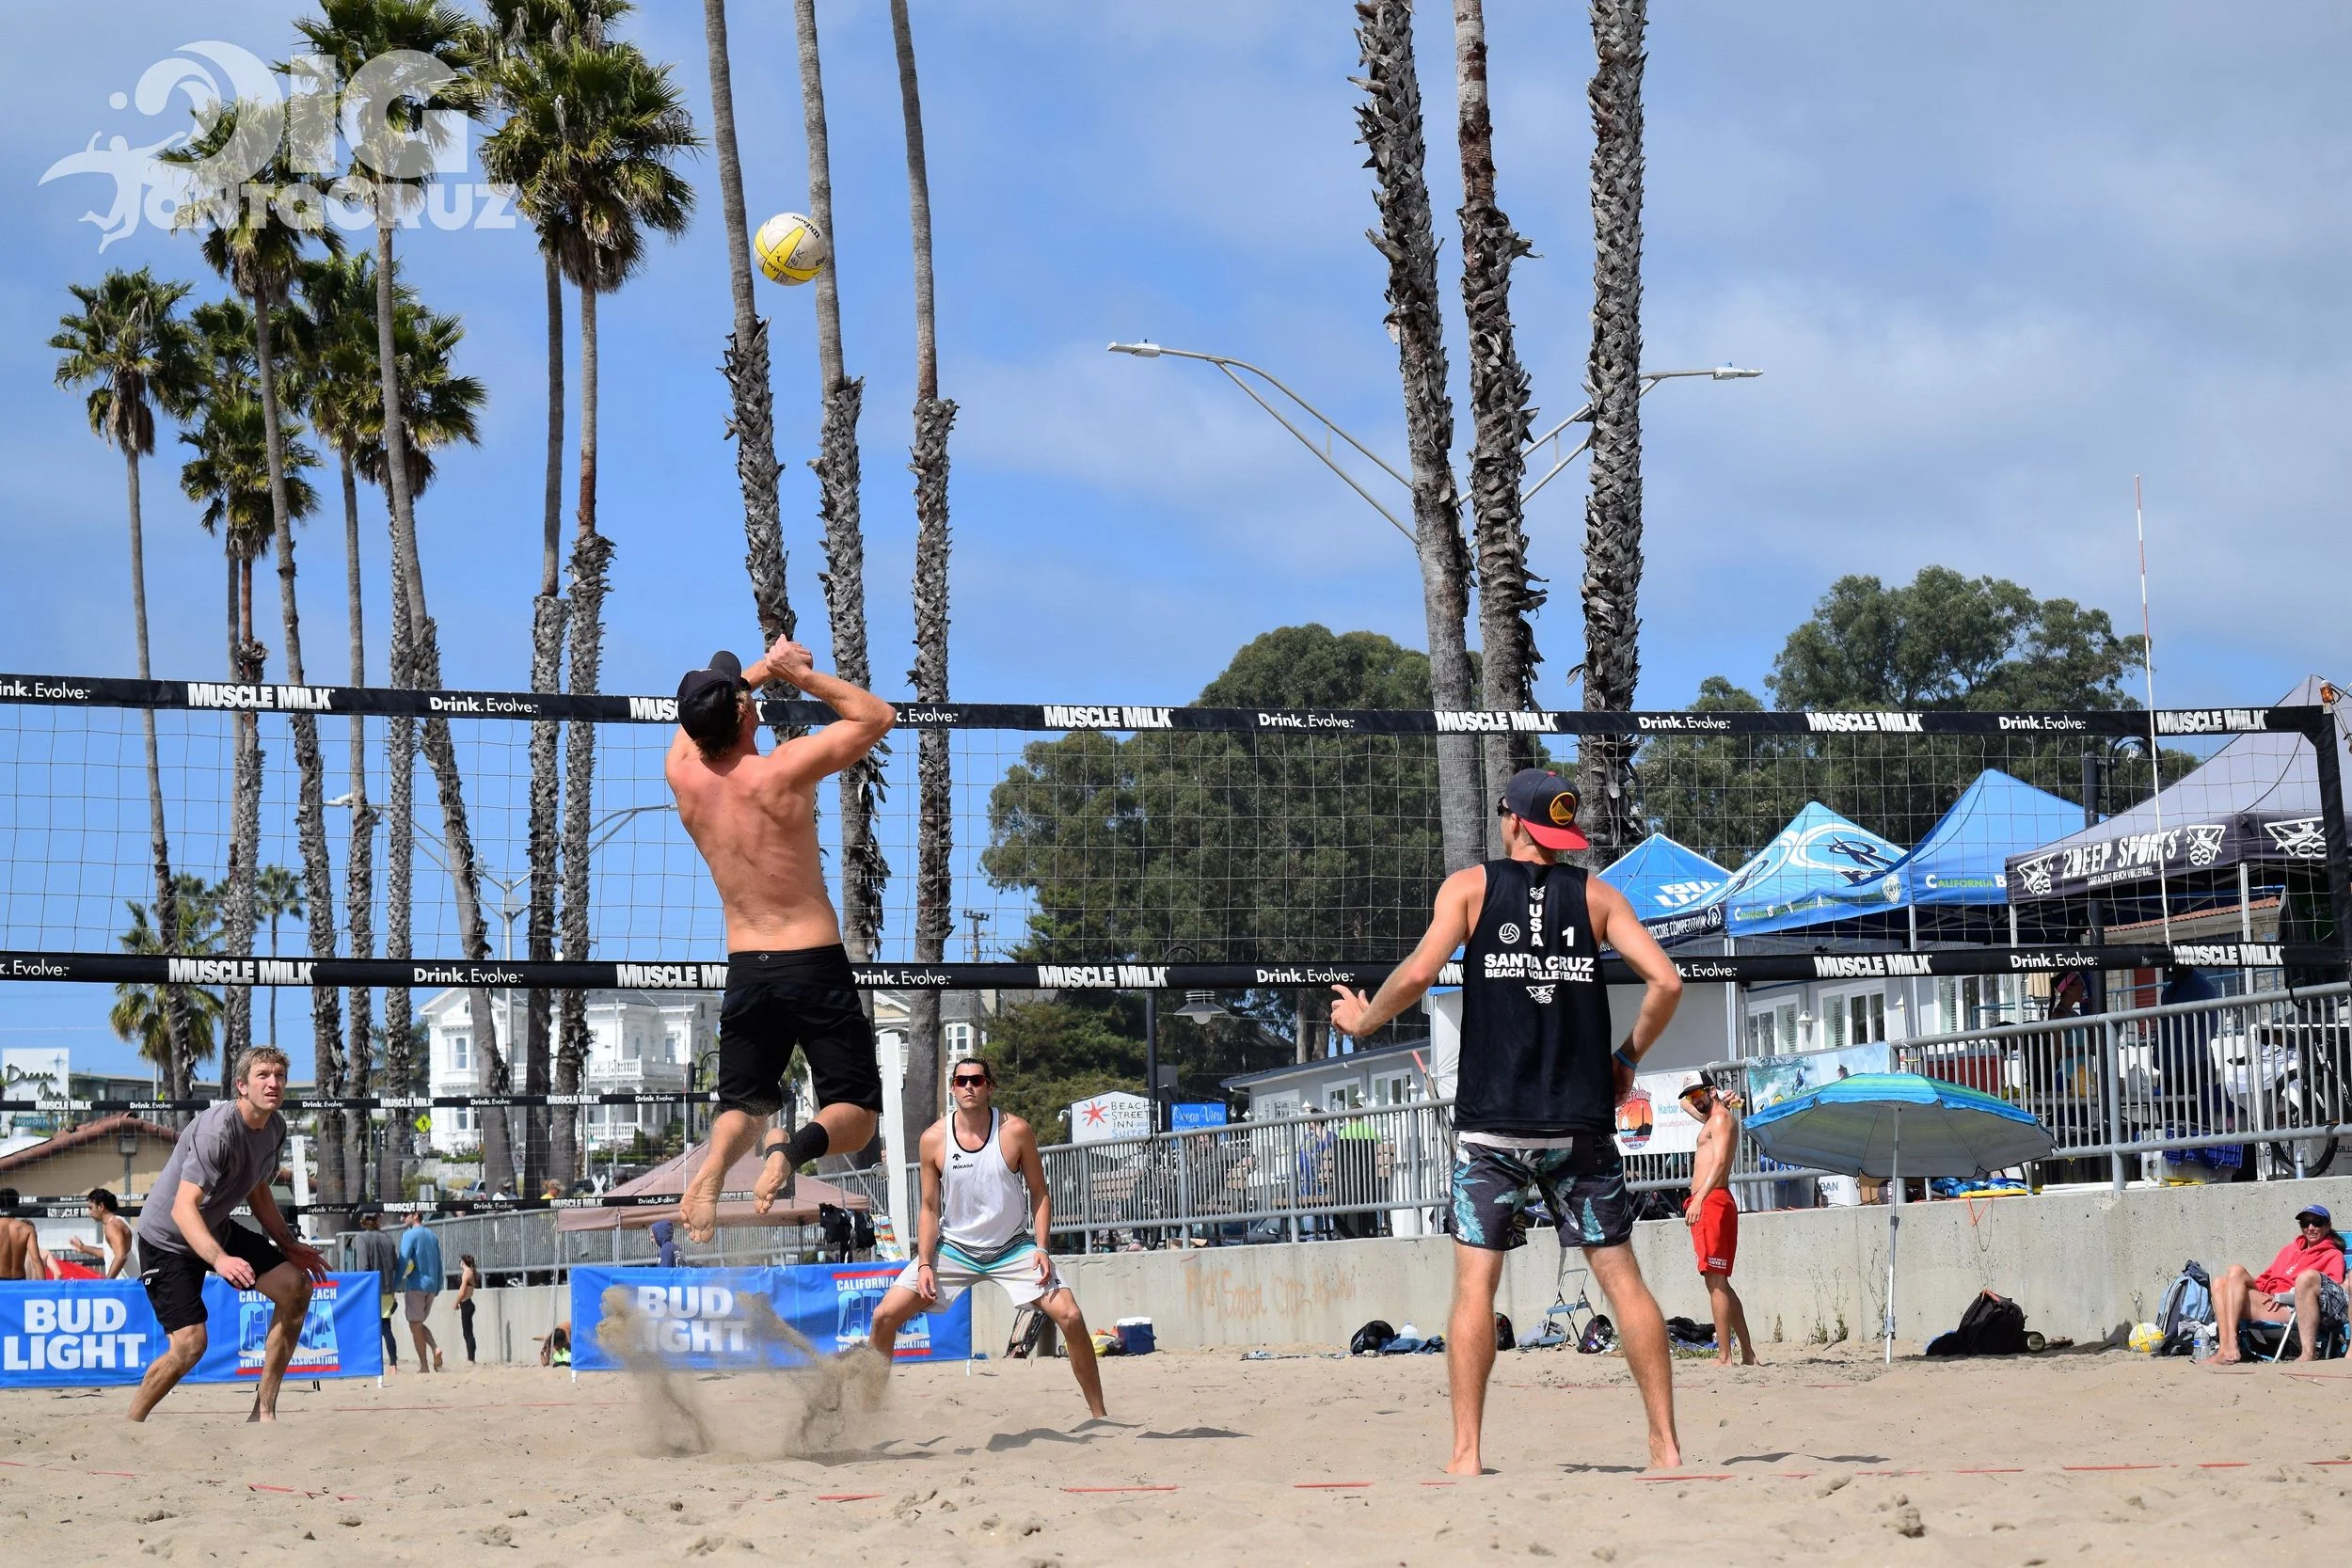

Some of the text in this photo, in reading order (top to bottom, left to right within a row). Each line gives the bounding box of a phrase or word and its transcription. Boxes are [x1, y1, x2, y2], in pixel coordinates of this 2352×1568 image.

[188, 681, 275, 708] MUSCLE
[430, 696, 484, 712] Drink.
[629, 697, 678, 721] MUS
[1042, 705, 1122, 728] MUSCLE
[1258, 713, 1306, 727] Drink.
[1436, 709, 1509, 733] MUSCLE
[1638, 716, 1686, 729] Drink.
[1805, 713, 1878, 732] MUSCLE
[1999, 716, 2043, 729] Drink.
[2156, 711, 2223, 733] MUSCLE
[1926, 874, 1992, 888] CALIFORNIA
[1529, 904, 1544, 946] USA
[1645, 923, 1670, 940] RDCORE
[1562, 927, 1575, 946] 1
[1485, 953, 1595, 973] SANTA CRUZ
[2010, 953, 2055, 968] Drink.
[2173, 945, 2238, 966] MUSCLE
[168, 956, 257, 983] MUSCLE
[414, 967, 468, 982] Drink.
[1256, 968, 1306, 982] Drink.
[1485, 968, 1593, 982] BEACH VOLLEYBALL
[1814, 957, 1884, 976] MUSCLE
[616, 964, 697, 988] MUSCLE
[1038, 966, 1115, 988] MUSCLE
[7, 1063, 58, 1084] Dream
[36, 1101, 92, 1111] MUSCLE MILK
[380, 1098, 434, 1107] MUSCLE MILK
[547, 1095, 600, 1105] MUSCLE MILK
[1111, 1101, 1150, 1110] BEACH
[1112, 1111, 1150, 1120] STREET
[384, 1201, 437, 1212] MUSCLE MILK
[550, 1198, 603, 1209] MUSCLE MILK
[836, 1277, 894, 1291] CALIFORNIA
[311, 1289, 337, 1300] EACH
[638, 1286, 733, 1319] BUD
[24, 1298, 126, 1334] BUD
[643, 1319, 747, 1353] IGHT
[894, 1339, 930, 1350] SOCIATION
[4, 1334, 146, 1370] LIGHT
